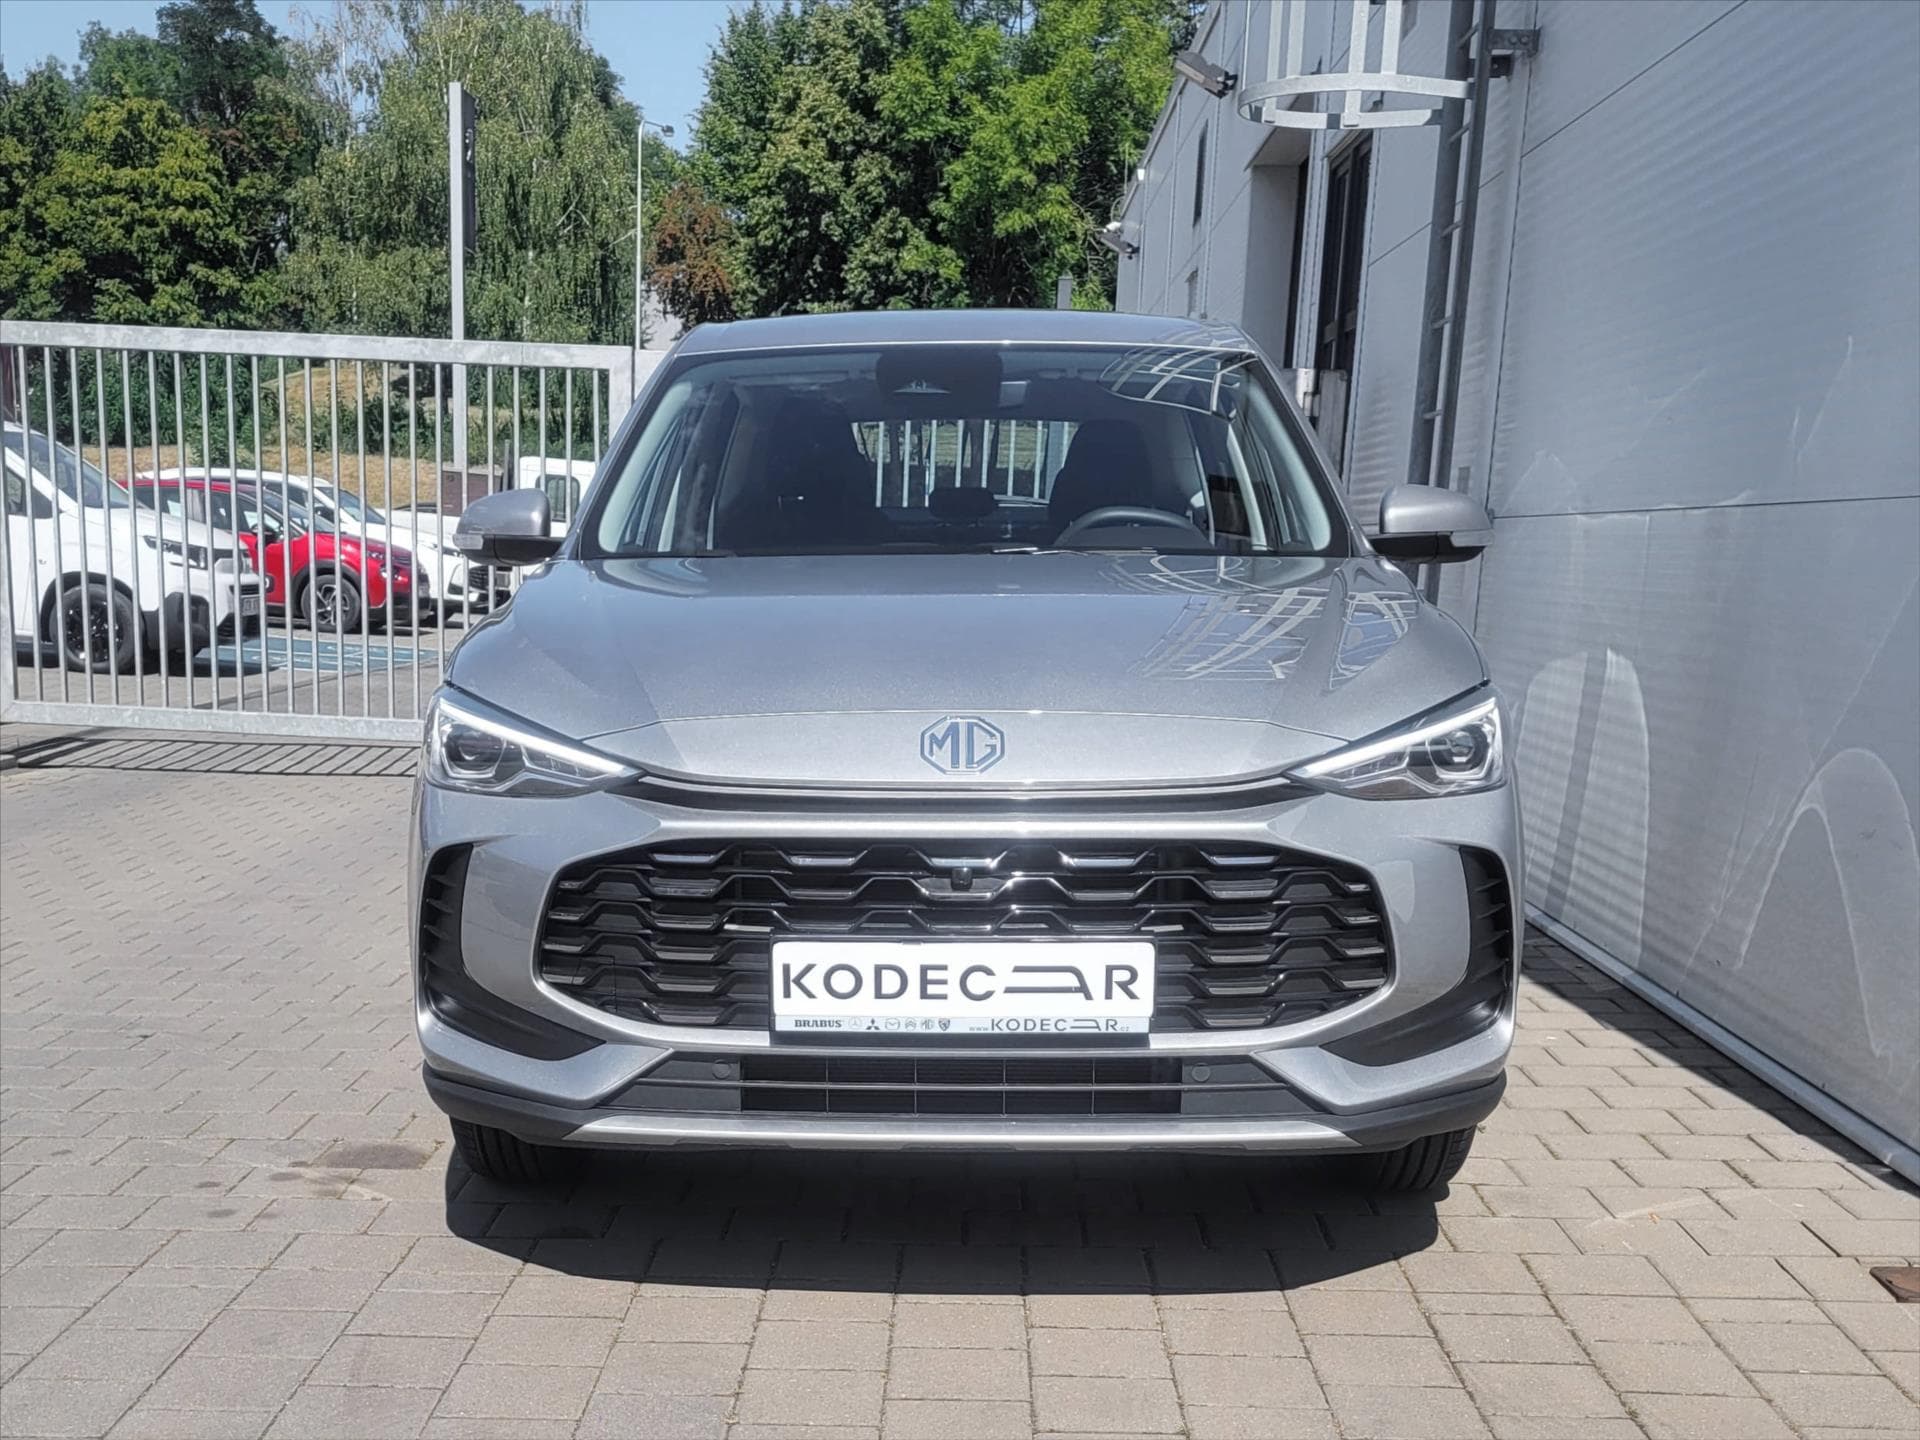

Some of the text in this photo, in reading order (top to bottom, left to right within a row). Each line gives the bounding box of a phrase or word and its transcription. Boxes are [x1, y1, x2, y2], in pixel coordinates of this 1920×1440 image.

[927, 720, 998, 770] MG
[781, 962, 1141, 1002] KODECAR
[794, 1018, 842, 1028] BRABUS
